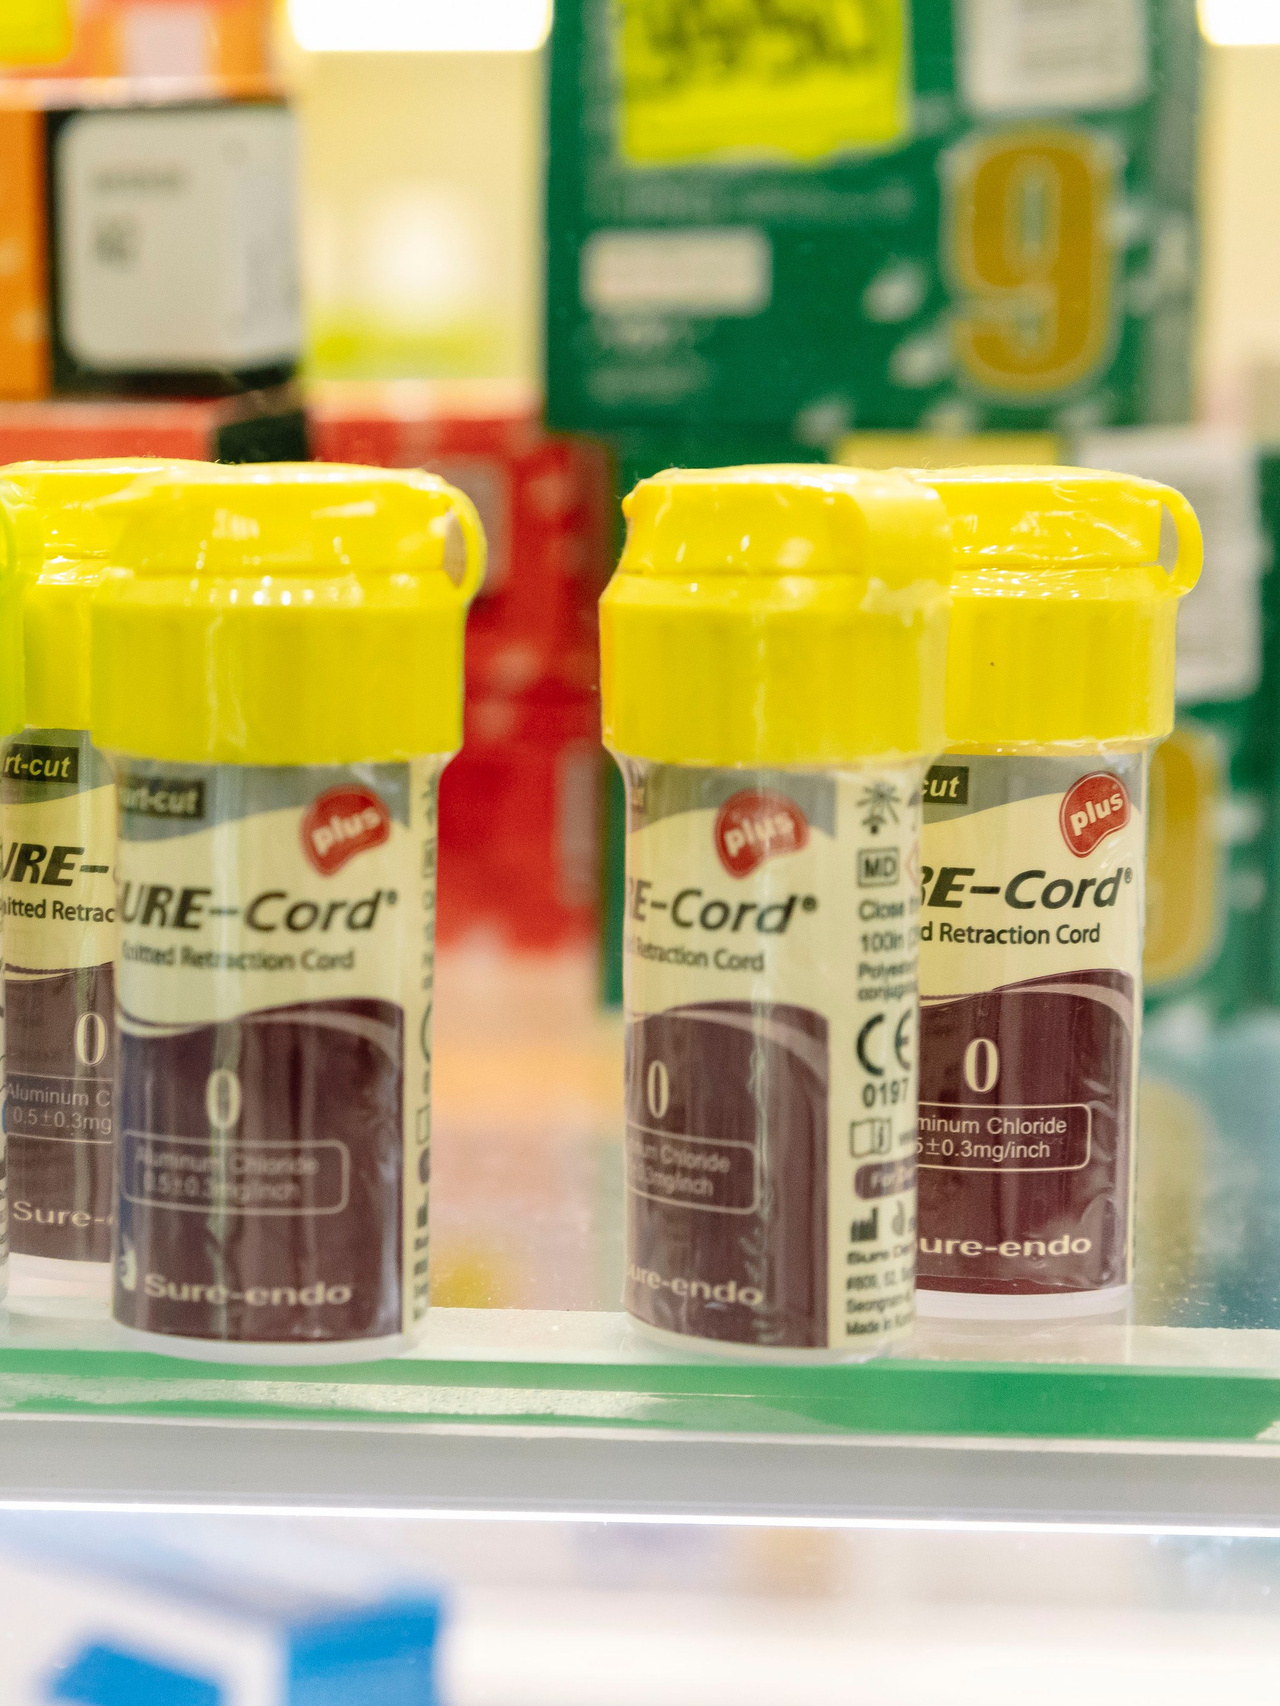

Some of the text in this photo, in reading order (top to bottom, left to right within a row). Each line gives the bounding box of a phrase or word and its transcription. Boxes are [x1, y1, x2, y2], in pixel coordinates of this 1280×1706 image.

[944, 126, 1122, 395] 9
[312, 805, 381, 856] plus
[723, 811, 796, 858] plus
[1070, 793, 1123, 836] plus
[940, 923, 1050, 944] Retraction
[1056, 923, 1101, 944] Cord
[300, 947, 355, 972] Cord
[75, 1011, 109, 1066] 0
[638, 1060, 669, 1119] 0
[963, 1038, 999, 1093] 0
[206, 1067, 241, 1130] 0
[986, 1117, 1067, 1135] Chloride
[144, 1273, 351, 1306] Sure-endo
